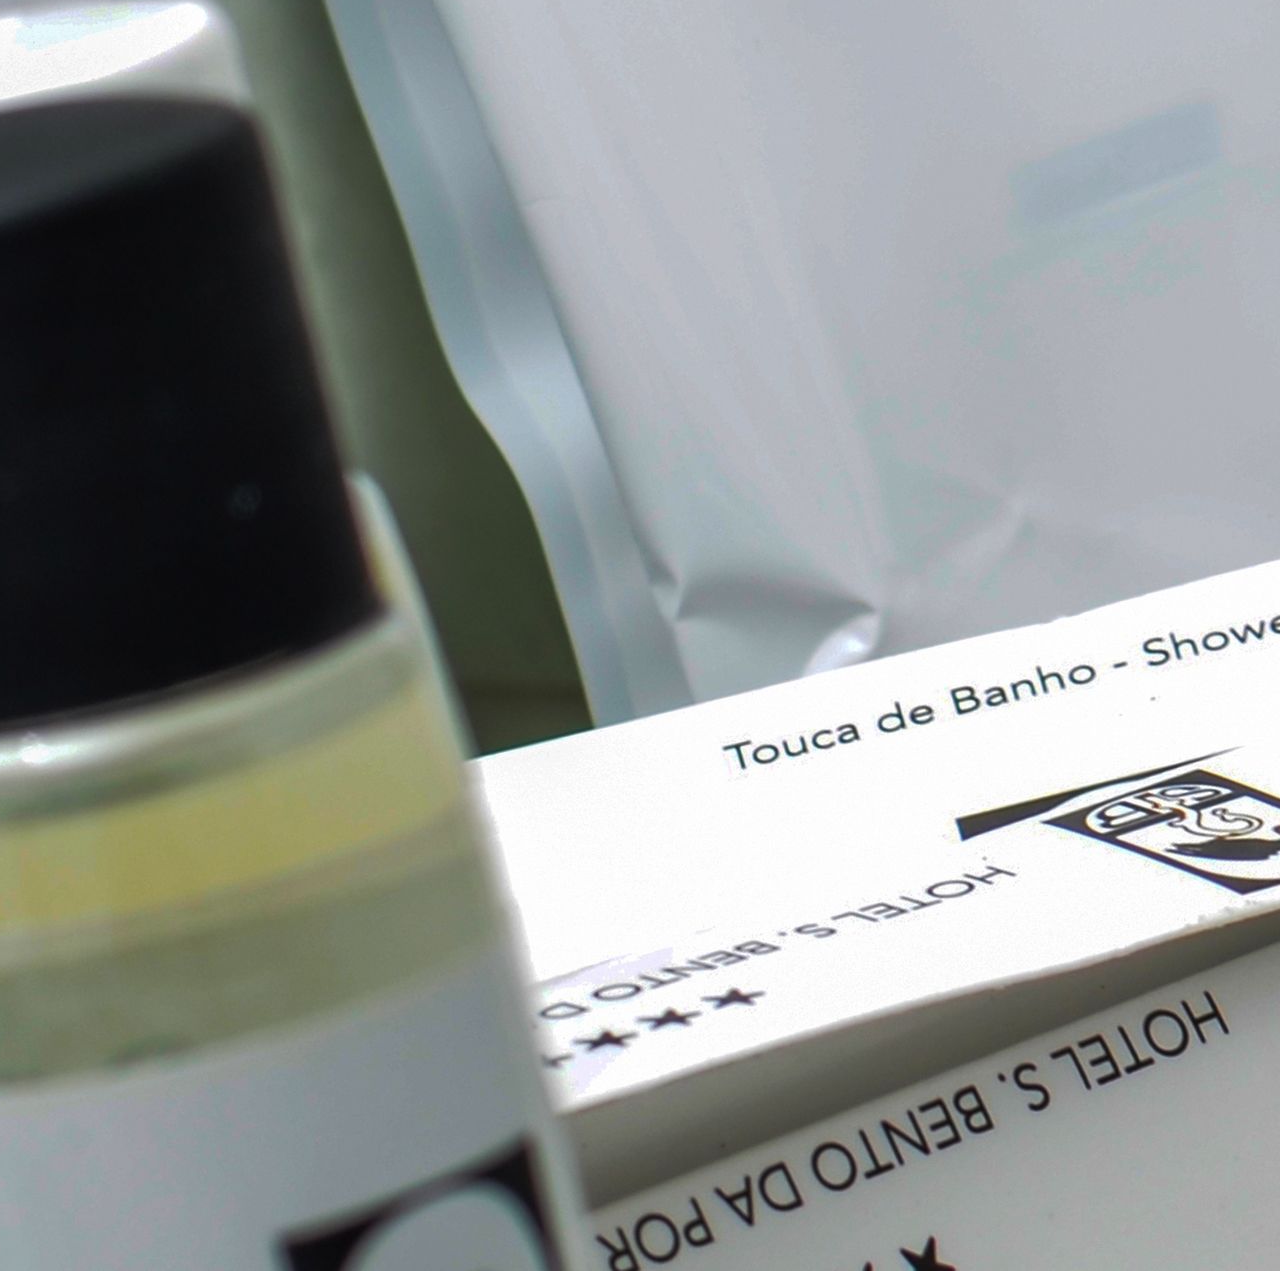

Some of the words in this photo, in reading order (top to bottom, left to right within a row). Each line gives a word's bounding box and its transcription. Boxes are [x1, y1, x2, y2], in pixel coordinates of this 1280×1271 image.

[722, 724, 860, 770] Touca
[877, 702, 934, 733] de
[950, 665, 1096, 715] Banho
[830, 864, 1017, 923] HOTEL
[777, 922, 838, 939] S.
[591, 939, 781, 1002] BENTO
[538, 1001, 590, 1020] D
[1050, 990, 1229, 1090] HOTEL
[997, 1063, 1050, 1111] S.
[811, 1085, 994, 1191] BENTO
[714, 1161, 804, 1227] DA
[596, 1197, 714, 1271] POR
